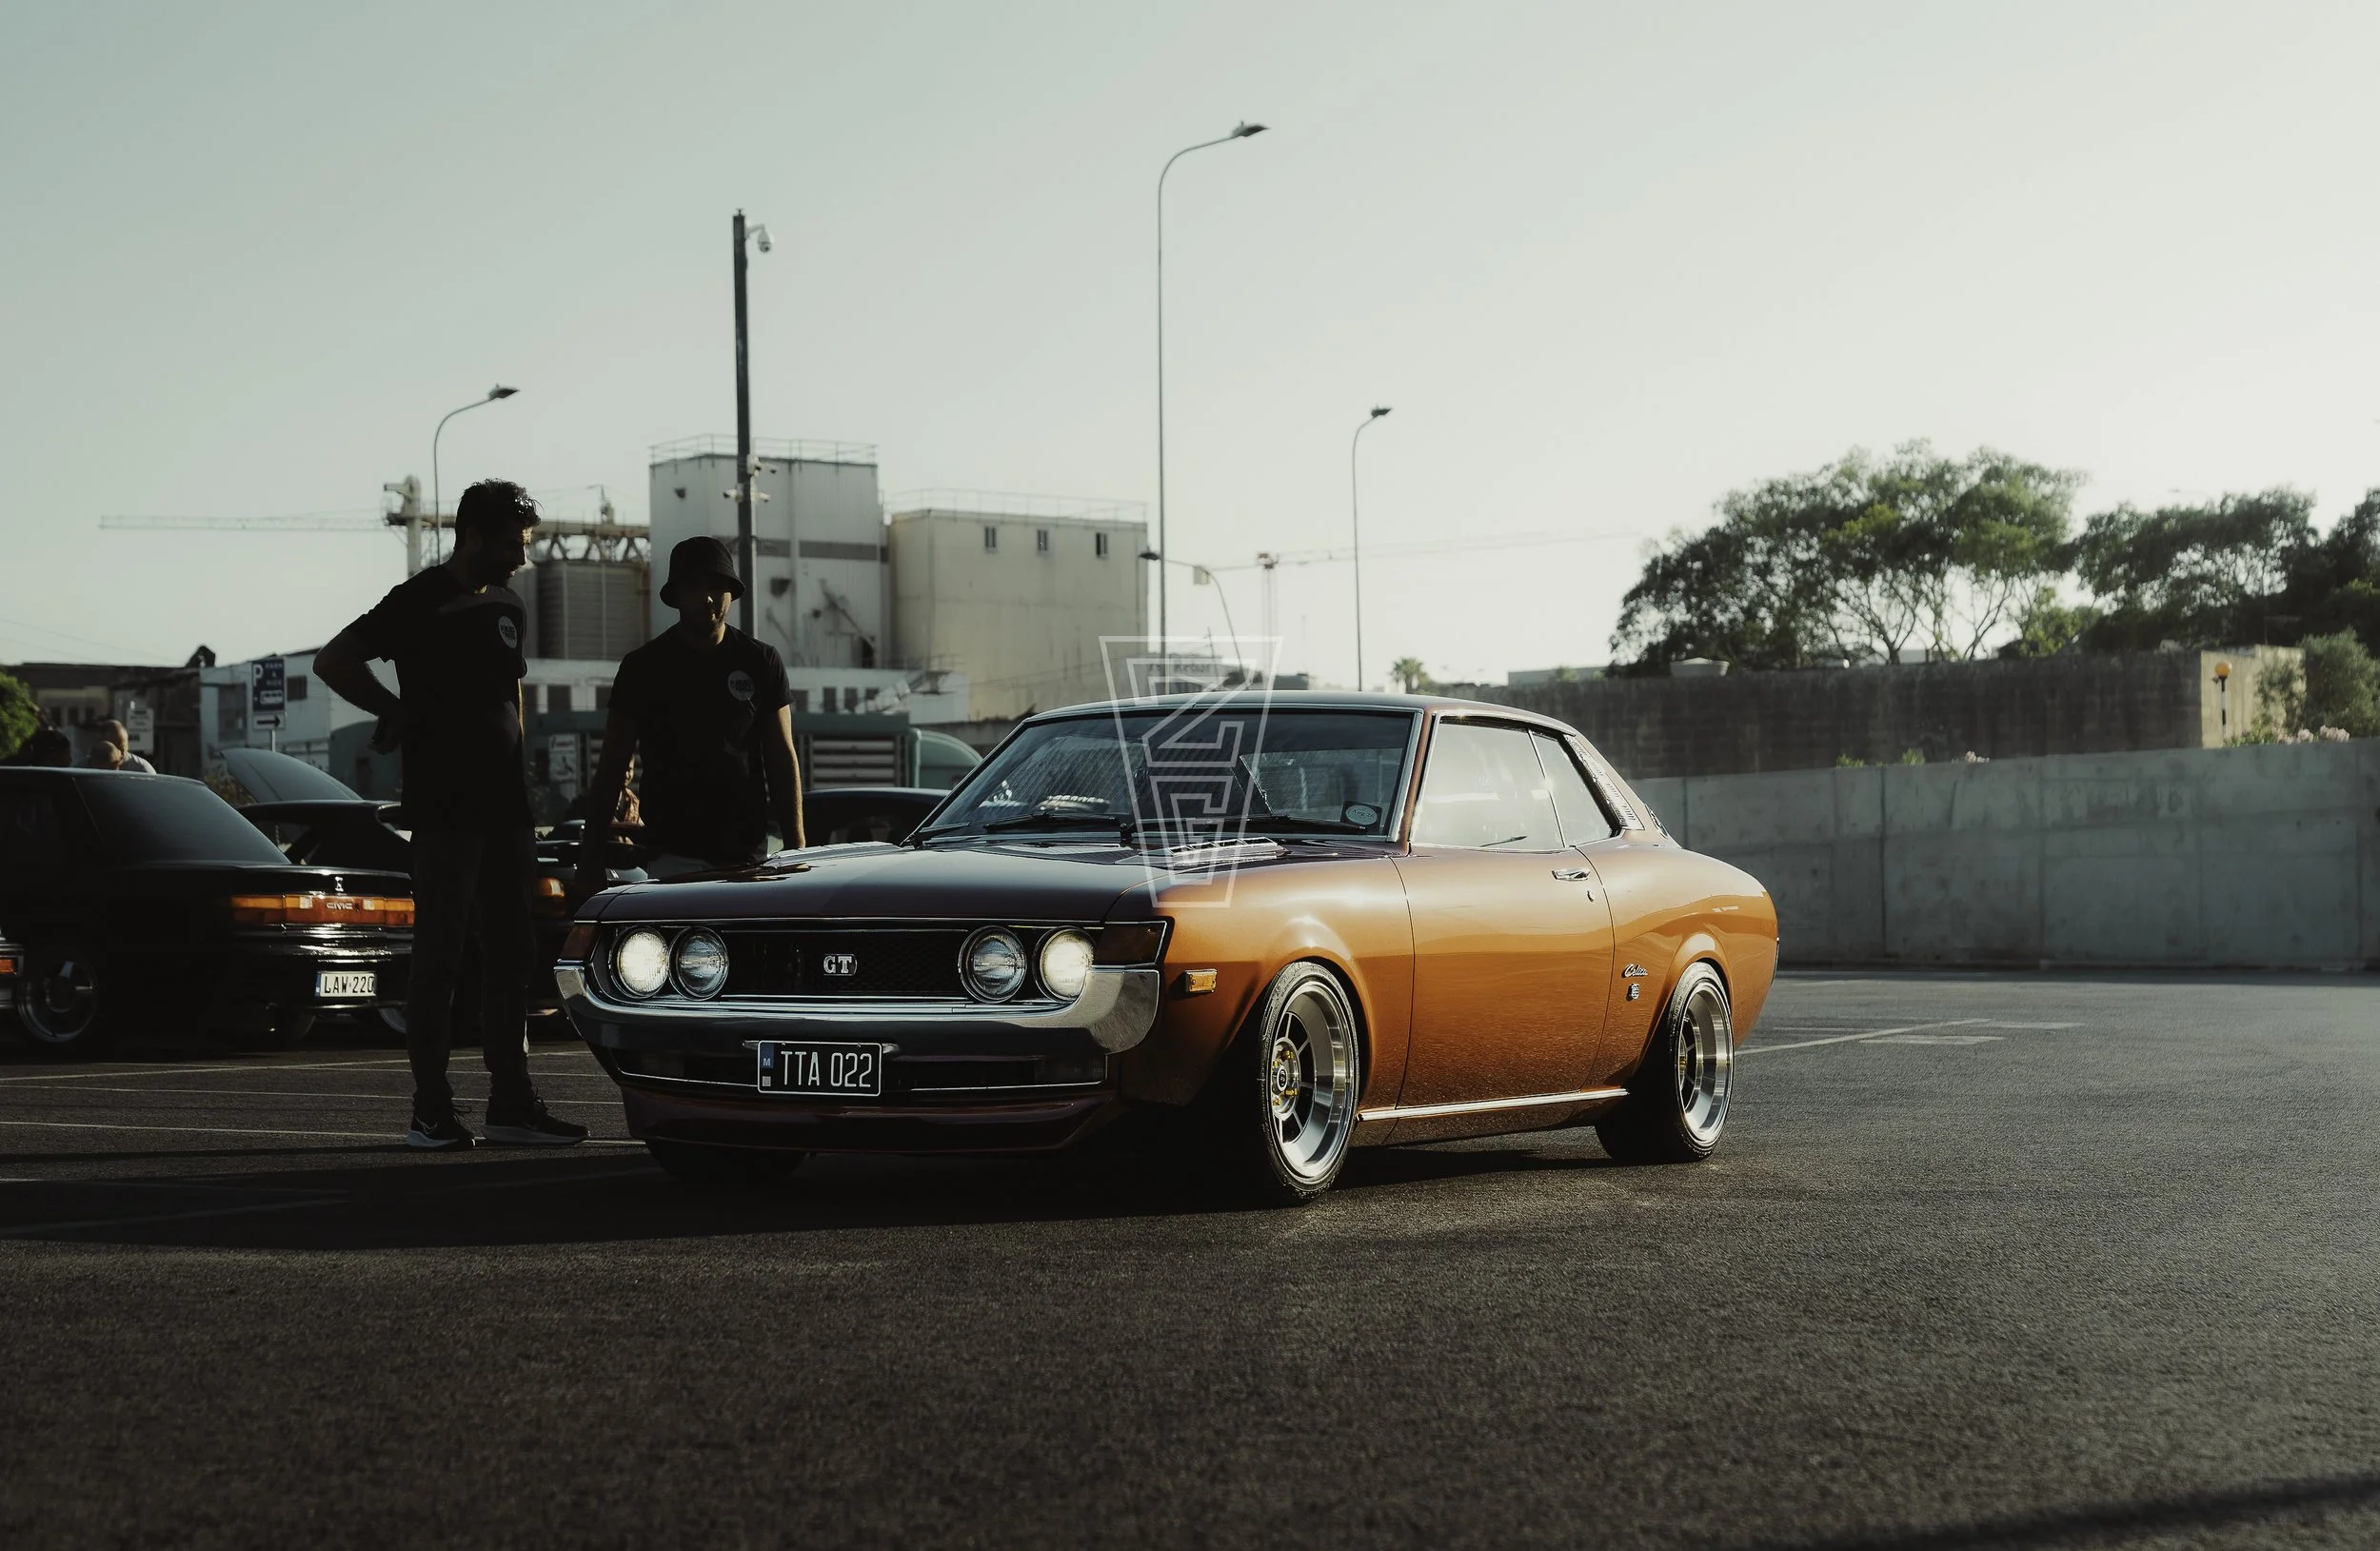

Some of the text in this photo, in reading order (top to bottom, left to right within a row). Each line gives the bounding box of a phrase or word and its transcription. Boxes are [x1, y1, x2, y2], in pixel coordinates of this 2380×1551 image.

[253, 664, 264, 686] P
[326, 902, 353, 910] CIVIC
[823, 955, 852, 974] GT
[1624, 964, 1648, 978] Celica
[763, 1058, 771, 1066] M
[781, 1050, 872, 1087] TTA 022
